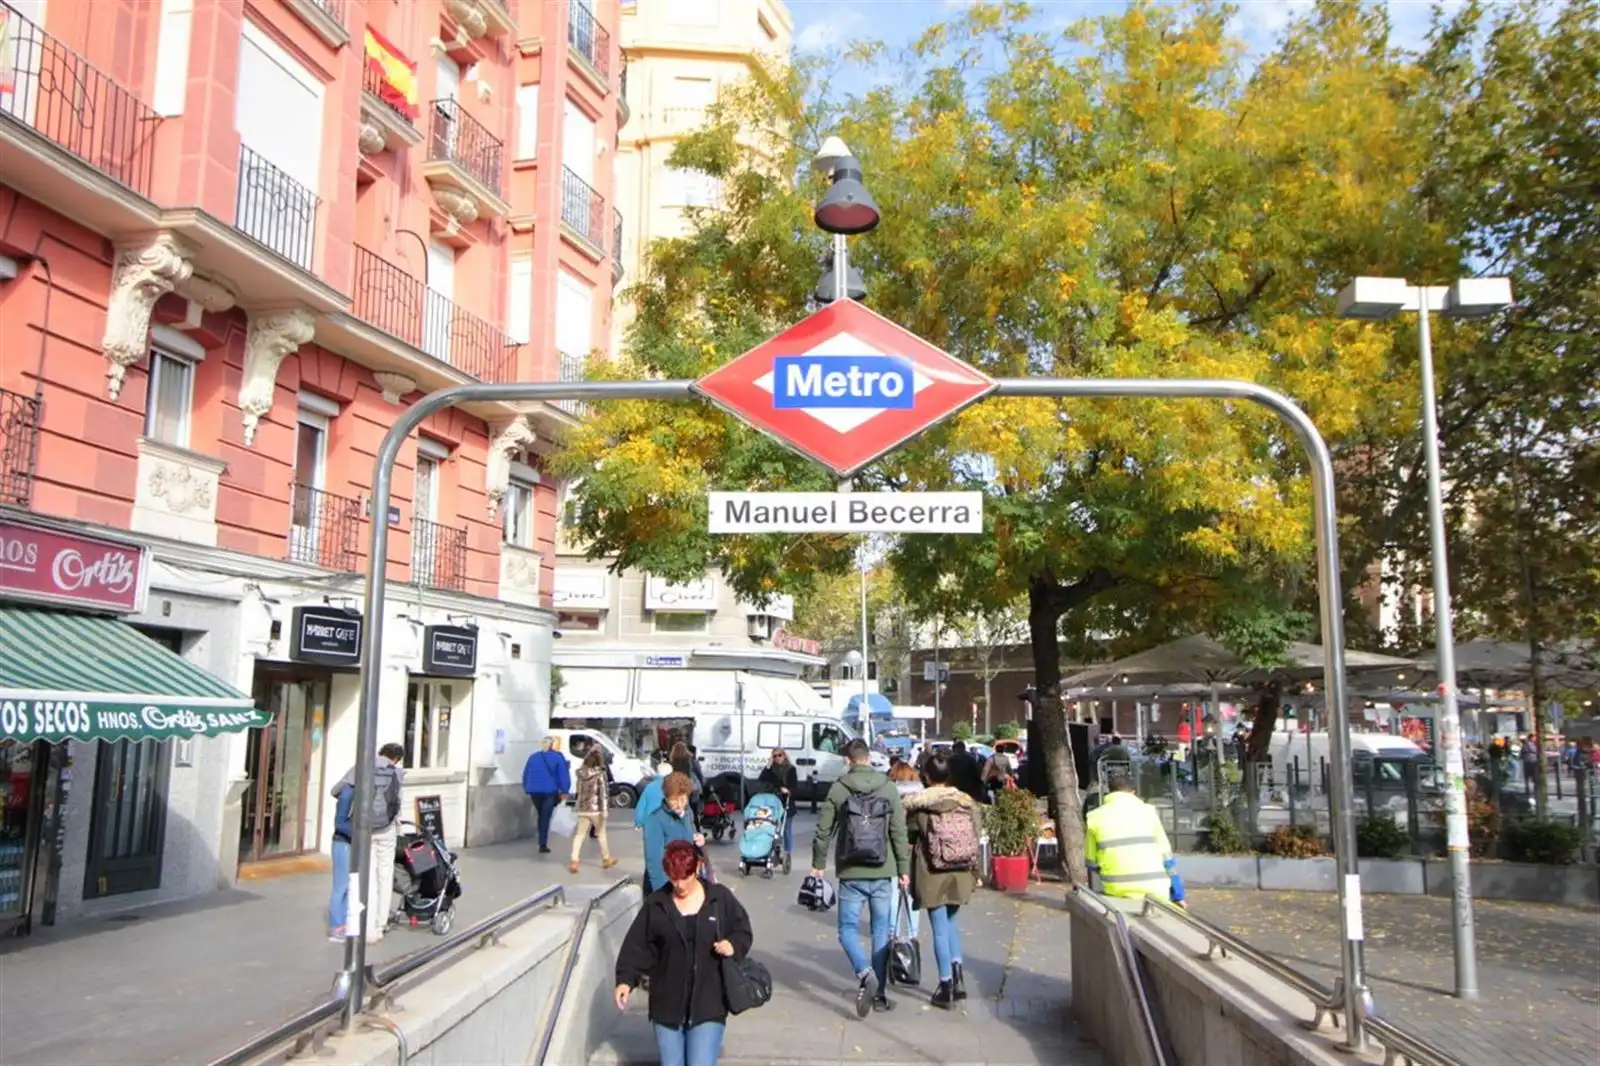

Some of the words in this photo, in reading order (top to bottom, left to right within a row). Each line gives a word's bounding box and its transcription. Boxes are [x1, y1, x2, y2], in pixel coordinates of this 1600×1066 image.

[786, 363, 904, 398] Metro
[724, 499, 837, 525] Manuel
[848, 499, 970, 525] Becerra
[0, 701, 28, 734] OS
[34, 701, 91, 734] SECOS
[97, 710, 142, 730] HNOS.
[207, 709, 262, 727] SANZ
